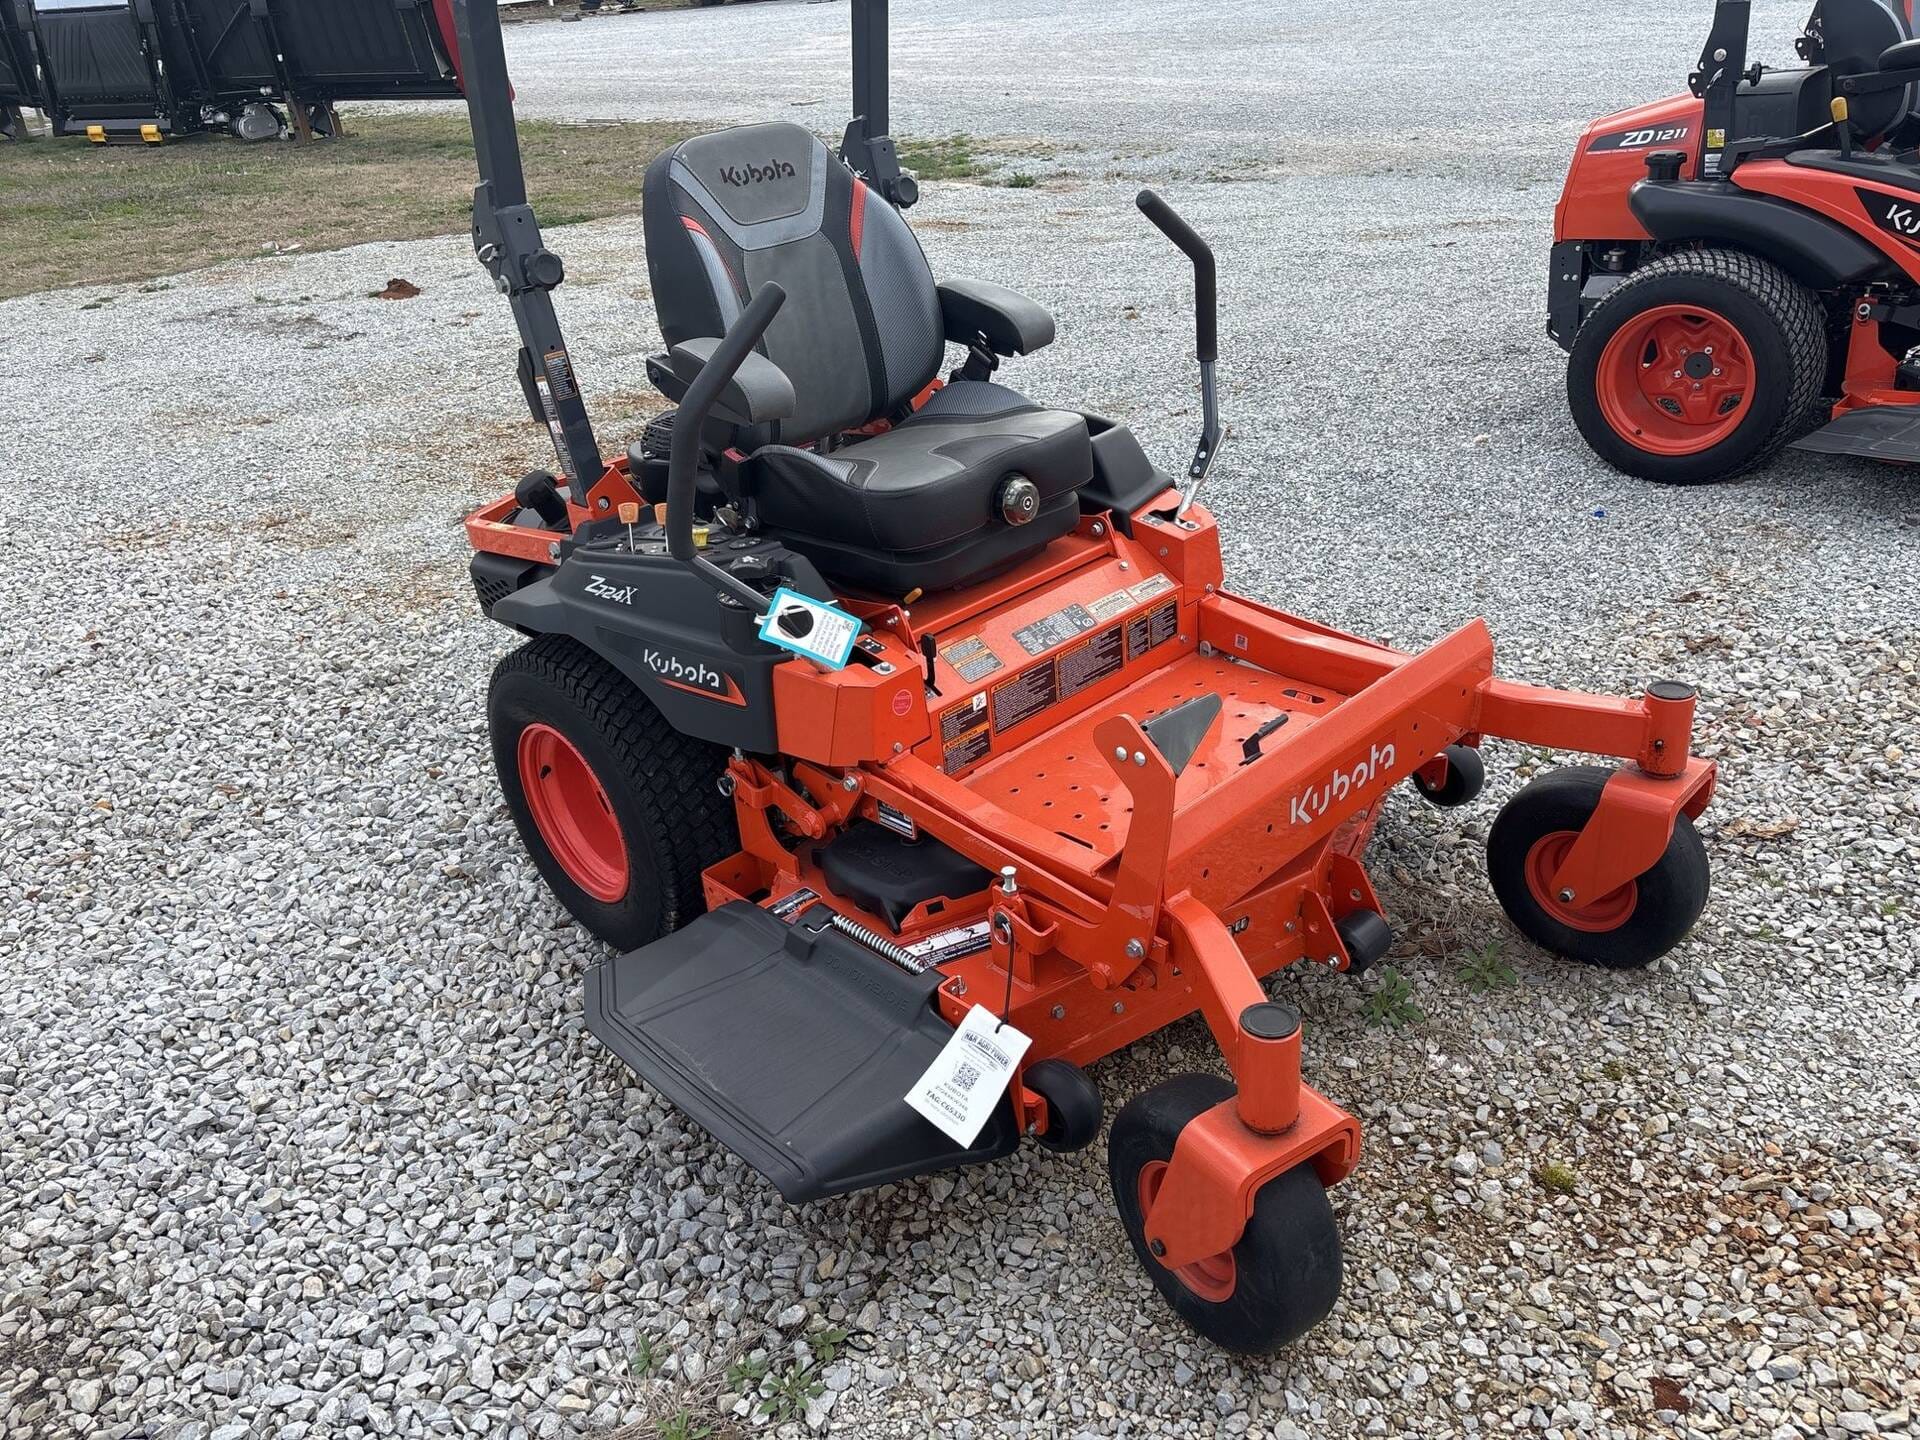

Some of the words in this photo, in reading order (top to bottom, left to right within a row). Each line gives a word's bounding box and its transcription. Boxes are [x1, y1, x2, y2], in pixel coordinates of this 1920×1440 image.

[720, 158, 796, 187] Kubota
[584, 575, 640, 605] Z724X
[643, 648, 720, 688] Kubota
[1289, 742, 1396, 825] Kubota
